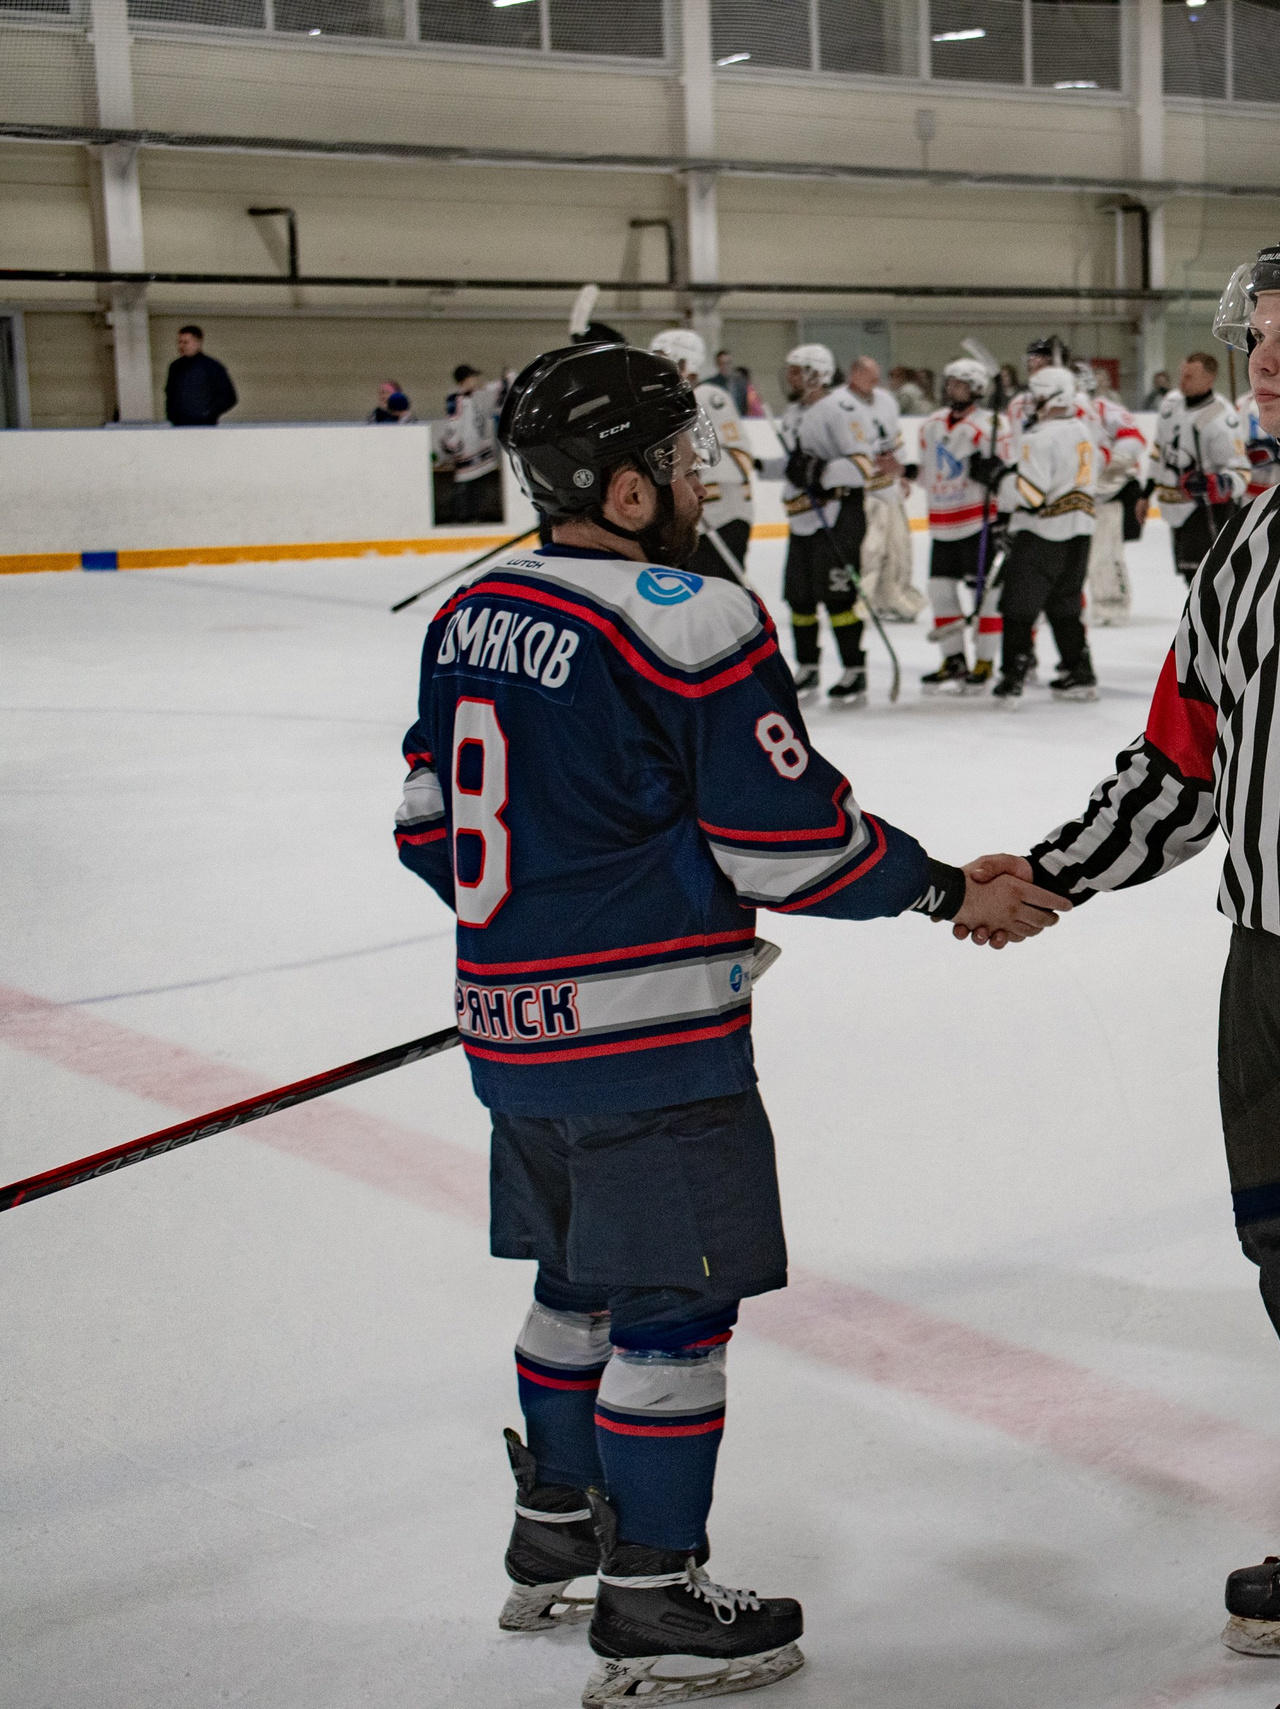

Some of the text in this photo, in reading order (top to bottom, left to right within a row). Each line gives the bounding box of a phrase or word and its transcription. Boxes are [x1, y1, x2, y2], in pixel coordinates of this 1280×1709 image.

[600, 421, 631, 439] CCM
[506, 559, 545, 569] LUTCH
[755, 711, 809, 780] 8
[452, 696, 513, 929] 8
[94, 1095, 295, 1176] JETSPEED
